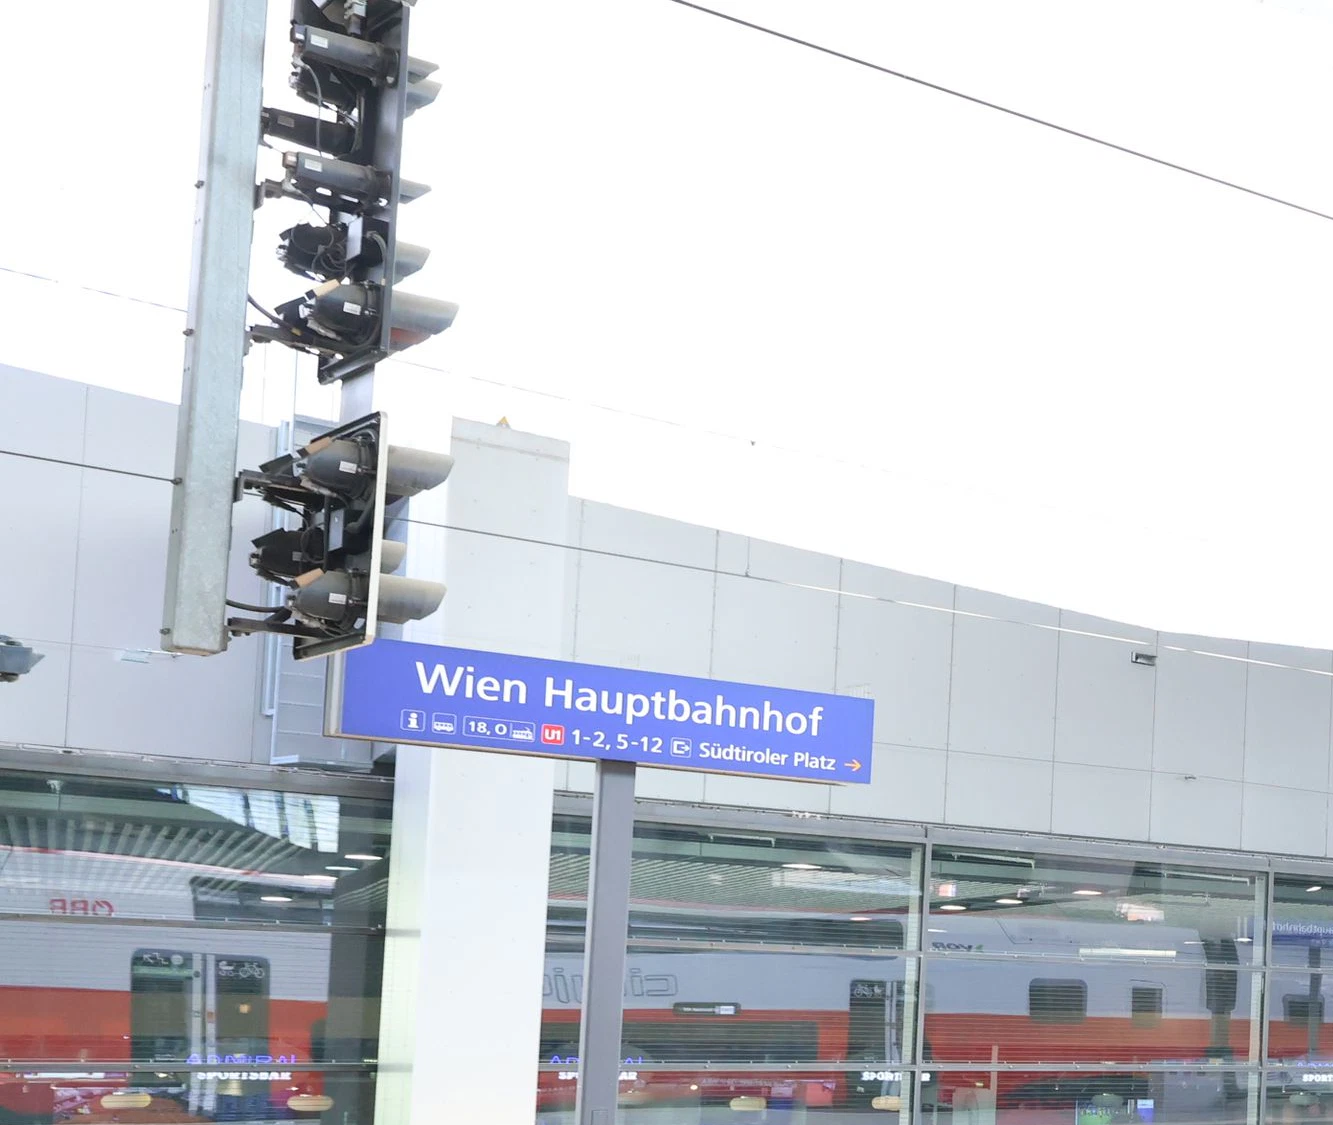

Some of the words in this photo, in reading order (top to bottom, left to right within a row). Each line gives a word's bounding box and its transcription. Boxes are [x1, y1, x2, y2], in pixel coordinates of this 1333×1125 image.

[415, 661, 527, 704] Wien
[544, 676, 824, 737] Hauptbahnhof
[468, 720, 491, 736] 18,
[544, 728, 561, 742] U1
[572, 729, 611, 750] 1-2,
[616, 733, 663, 754] 5-12
[699, 742, 789, 766] Südtiroler
[793, 752, 836, 771] Platz
